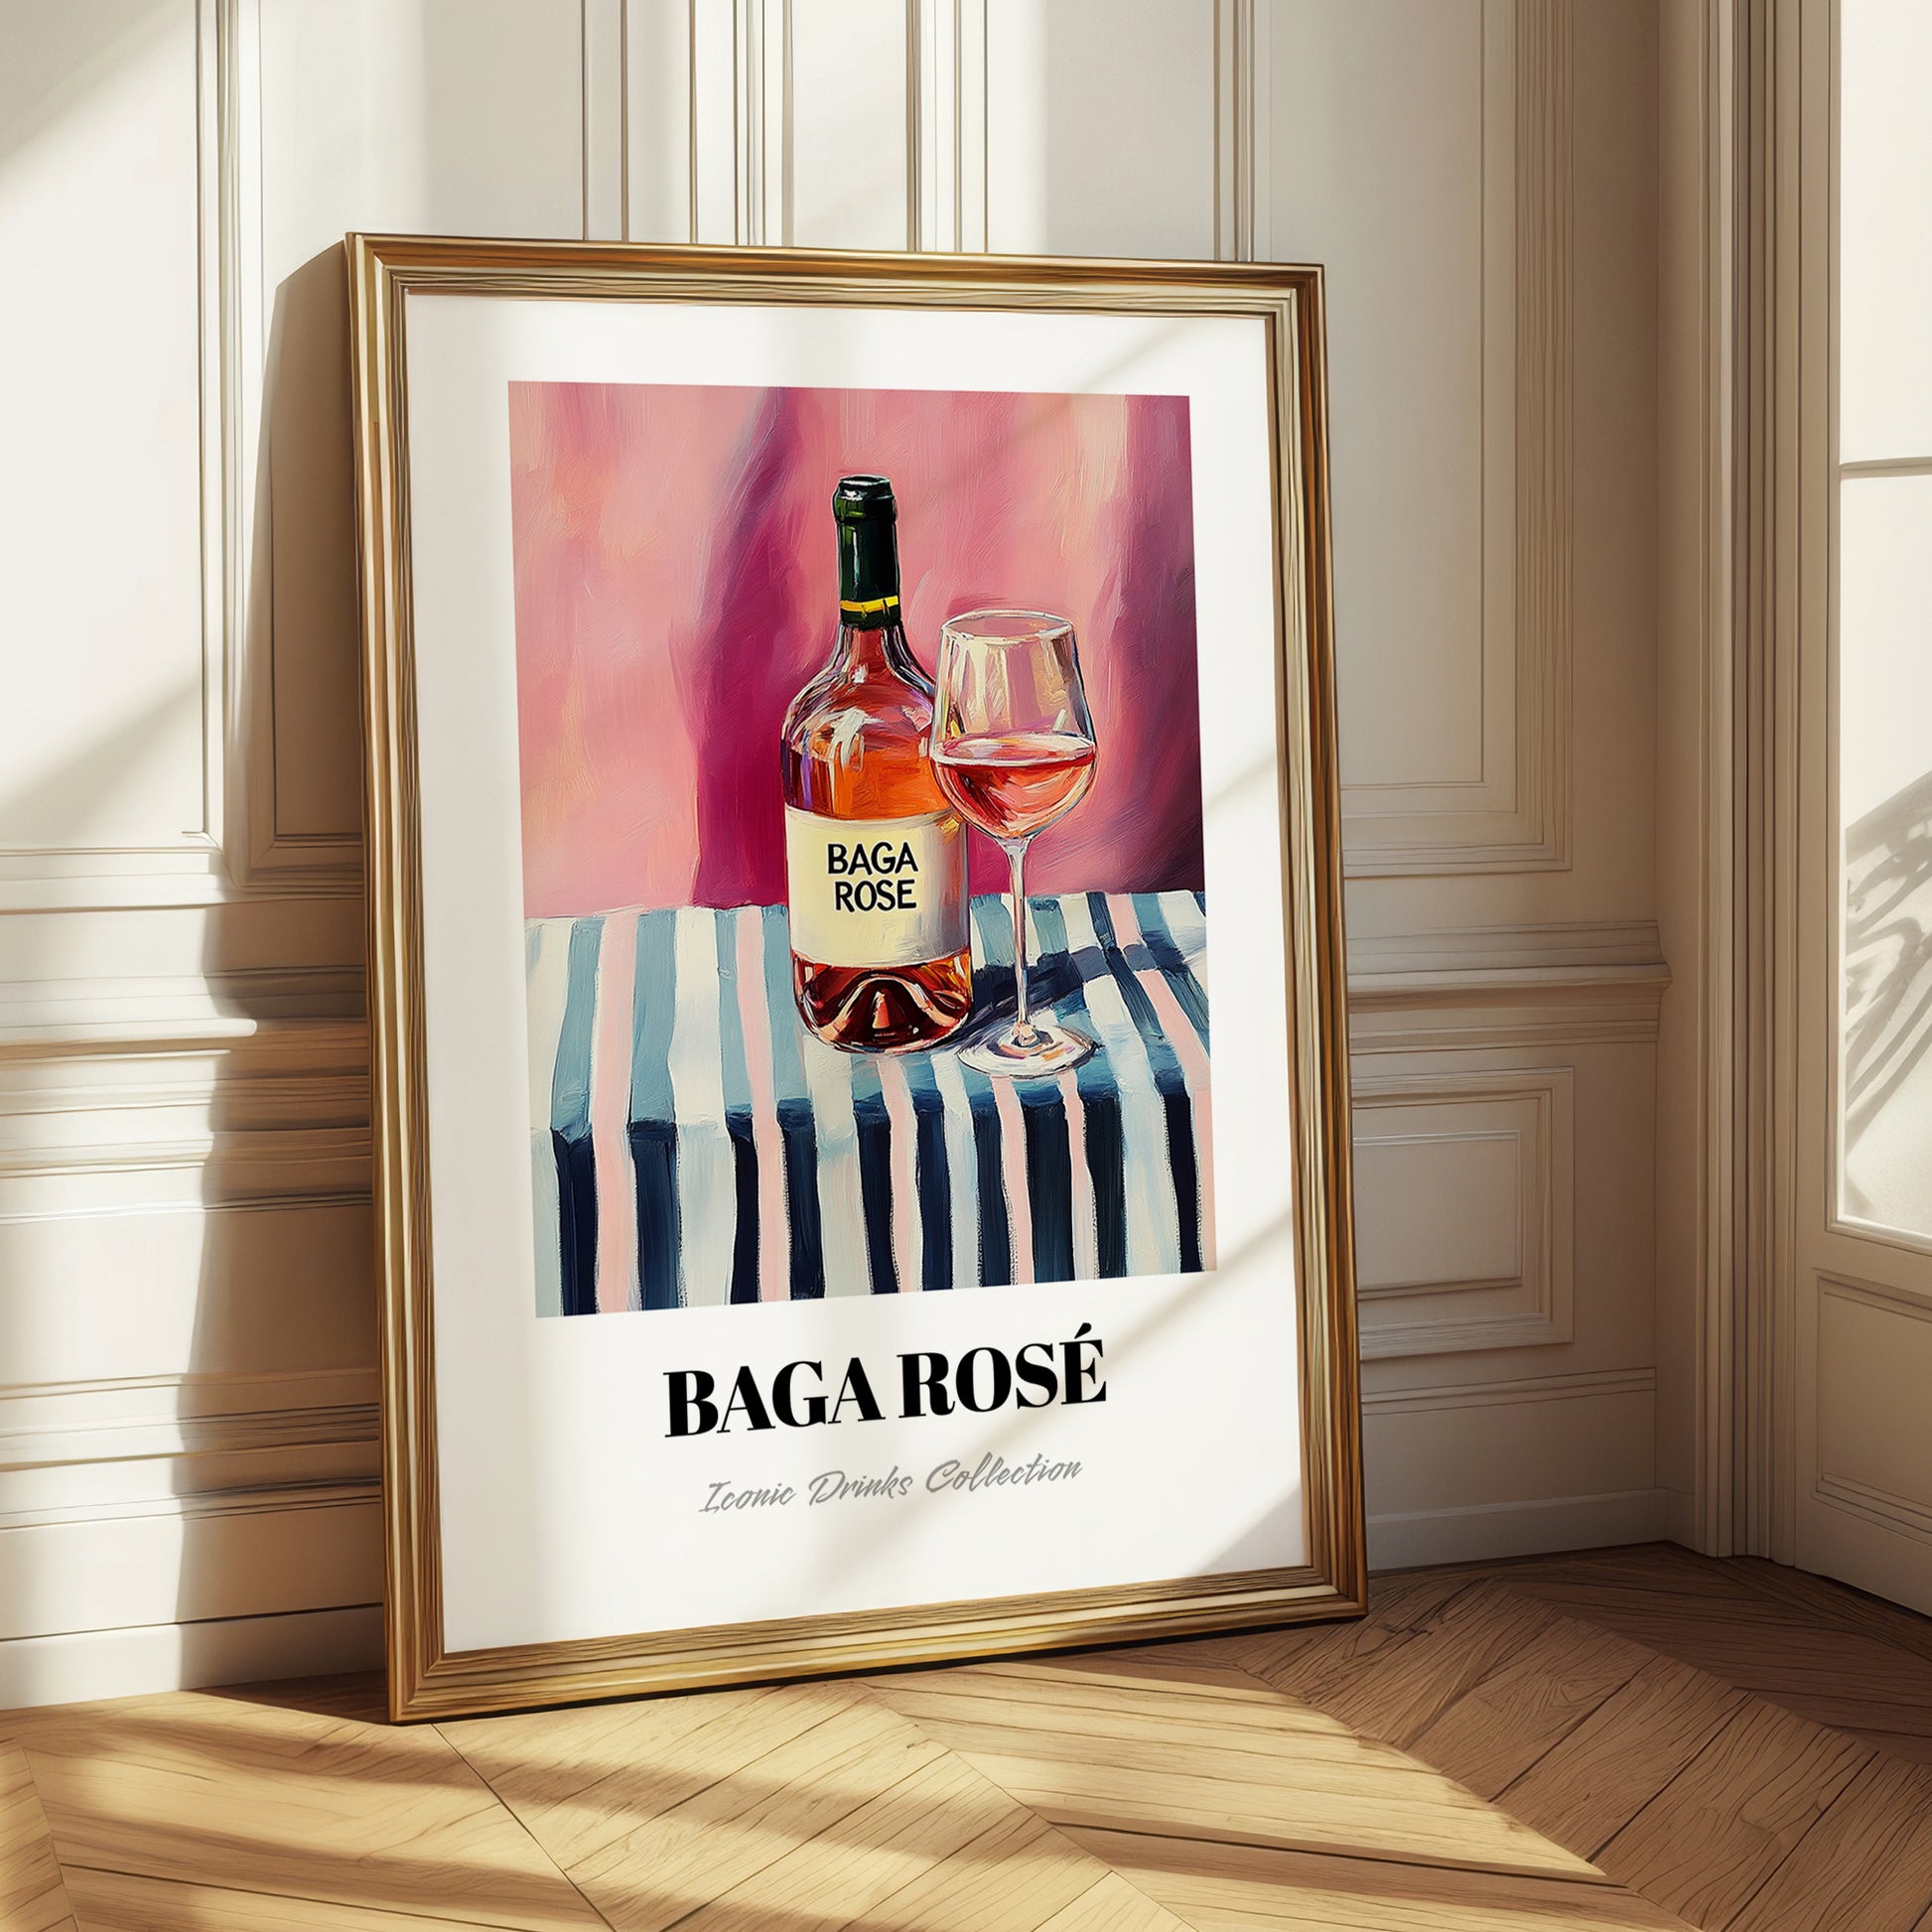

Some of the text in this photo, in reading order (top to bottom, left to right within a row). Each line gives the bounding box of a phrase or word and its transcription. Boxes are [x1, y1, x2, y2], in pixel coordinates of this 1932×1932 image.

[827, 842, 919, 876] BAGA
[834, 879, 917, 913] ROSE
[662, 1321, 1107, 1439] BAGA ROSÉ
[698, 1450, 1083, 1514] Iconic Drinks Collection
